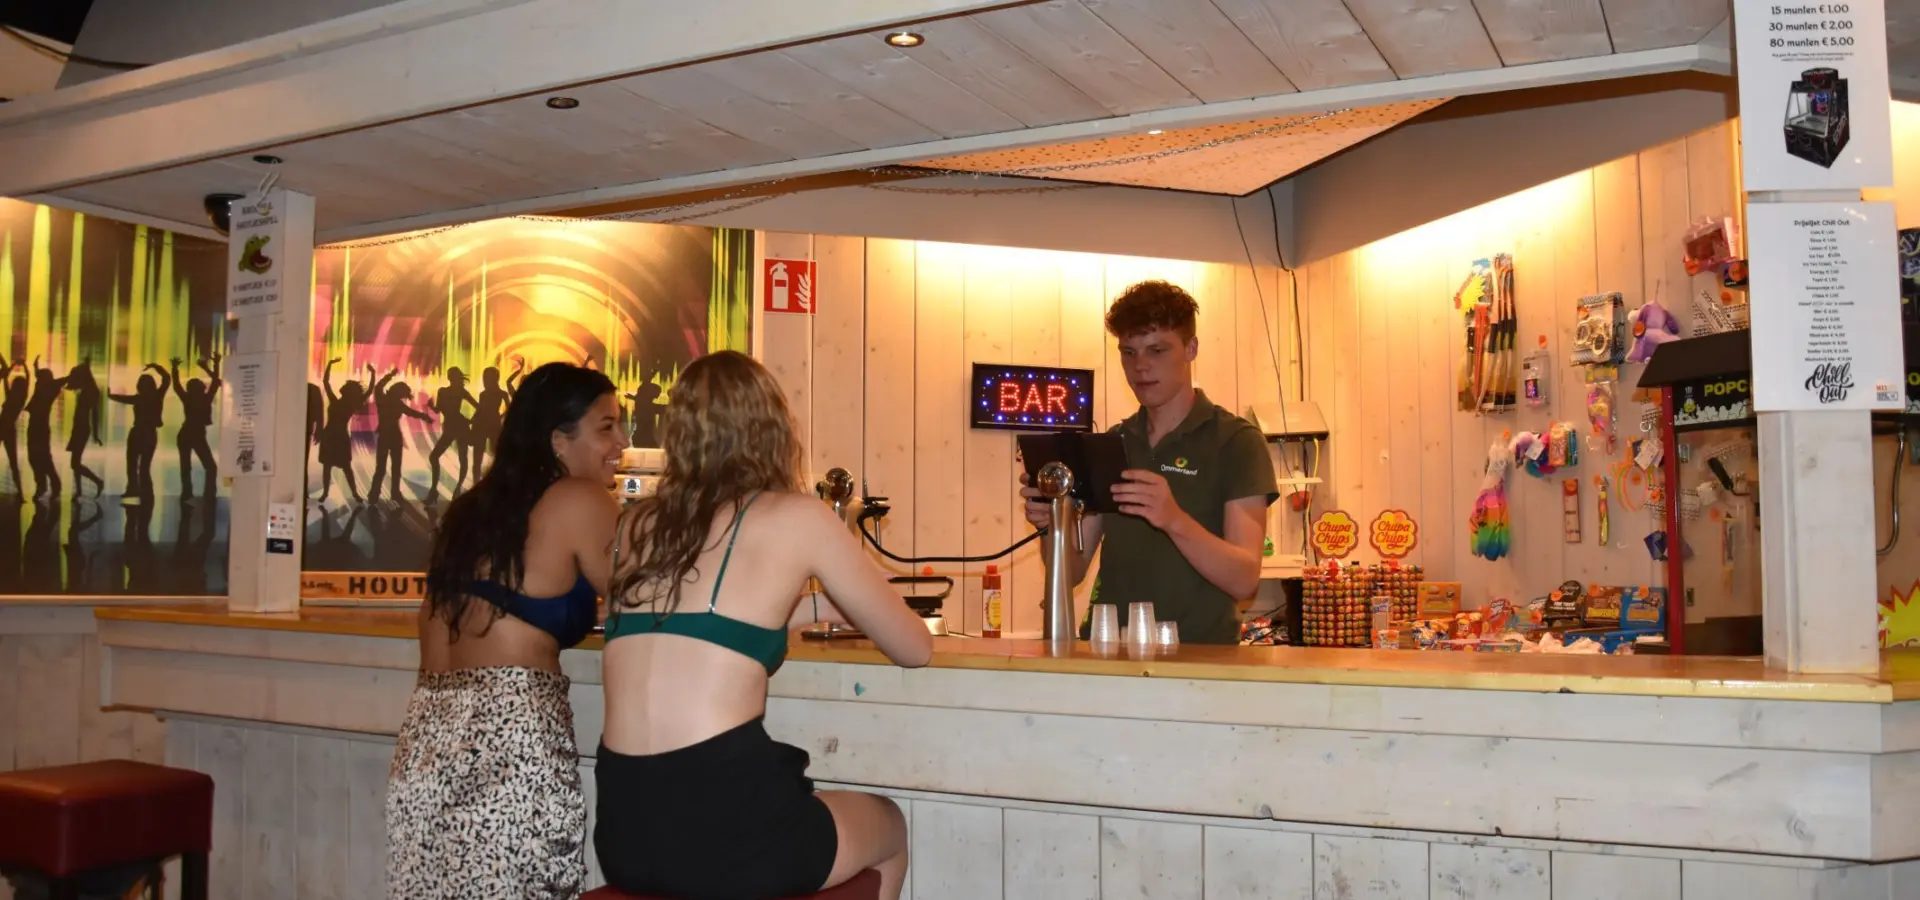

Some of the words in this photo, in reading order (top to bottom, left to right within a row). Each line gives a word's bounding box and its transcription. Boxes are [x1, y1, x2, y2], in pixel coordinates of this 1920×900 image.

[1771, 5, 1781, 15] 15
[1769, 22, 1783, 31] 30
[1770, 38, 1784, 48] 80
[1805, 362, 1850, 391] Chill
[1704, 379, 1749, 397] POPC
[1819, 383, 1854, 404] Out
[1000, 383, 1067, 413] BAR
[1317, 521, 1352, 535] Chupa
[1377, 520, 1411, 534] Chupa
[1316, 532, 1350, 550] Chups
[1376, 532, 1409, 549] Chups
[348, 576, 427, 595] HOUT
